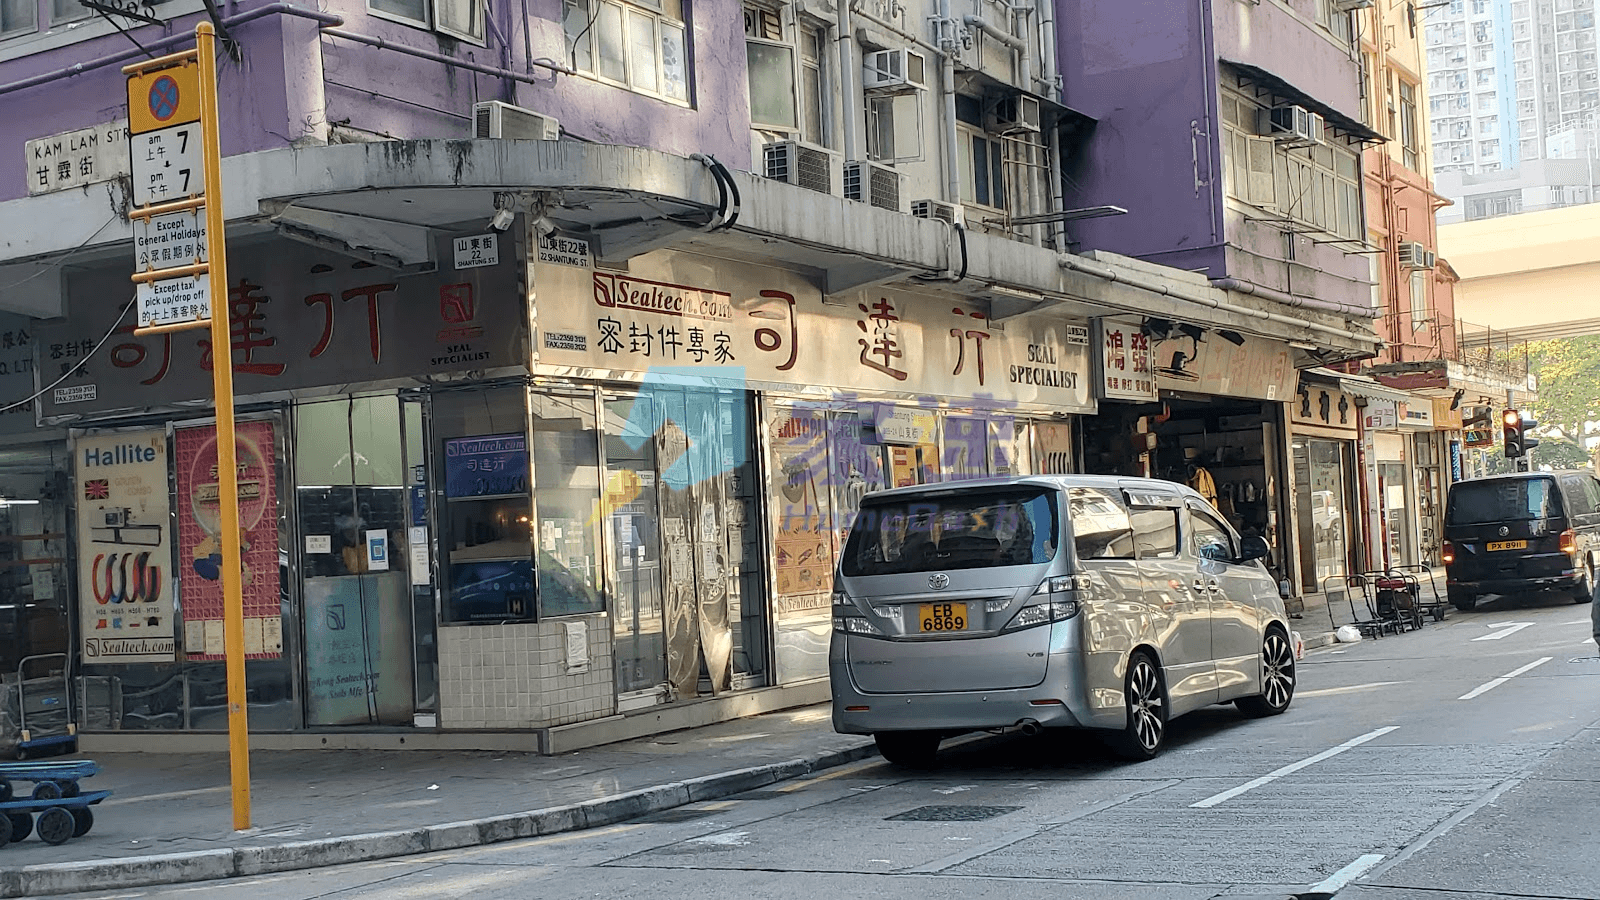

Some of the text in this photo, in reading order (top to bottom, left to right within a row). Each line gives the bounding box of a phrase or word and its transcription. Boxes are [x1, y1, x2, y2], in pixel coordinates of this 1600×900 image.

[35, 142, 61, 159] KAM
[70, 134, 98, 151] LAM
[149, 131, 188, 154] am 7
[146, 146, 166, 161] 上午
[36, 155, 93, 186] 甘霖街
[151, 168, 190, 192] pm 7
[148, 184, 168, 199] 下午
[157, 218, 184, 231] Except
[138, 228, 206, 246] General Holidays
[458, 237, 492, 252] 山東街
[540, 237, 588, 255] 山東街22號
[140, 242, 206, 265] 公眾假期例外
[458, 258, 487, 267] SHANTUNG
[472, 250, 481, 259] 22
[540, 253, 589, 267] 22 SHANTUNG ST.
[154, 280, 195, 294] Except taxi
[145, 289, 204, 307] pick up/drop off
[616, 280, 732, 319] Sealtech.com
[142, 304, 209, 322] 的士上落客除外
[104, 261, 399, 386] 司達行
[597, 315, 735, 364] 密封件專家
[749, 290, 991, 387] 司達行
[50, 338, 96, 360] 密封件
[447, 343, 472, 354] SEAL
[1028, 344, 1056, 365] SEAL
[431, 352, 490, 366] SPECIALIST
[1009, 364, 1078, 389] SPECIALIST
[86, 444, 156, 467] Hallite
[461, 440, 524, 453] Sealtech.com
[467, 457, 507, 472] 司達行
[1505, 541, 1522, 549] 8911
[933, 605, 952, 618] EB
[923, 617, 964, 632] 6869
[101, 639, 174, 654] Sealtech.com
